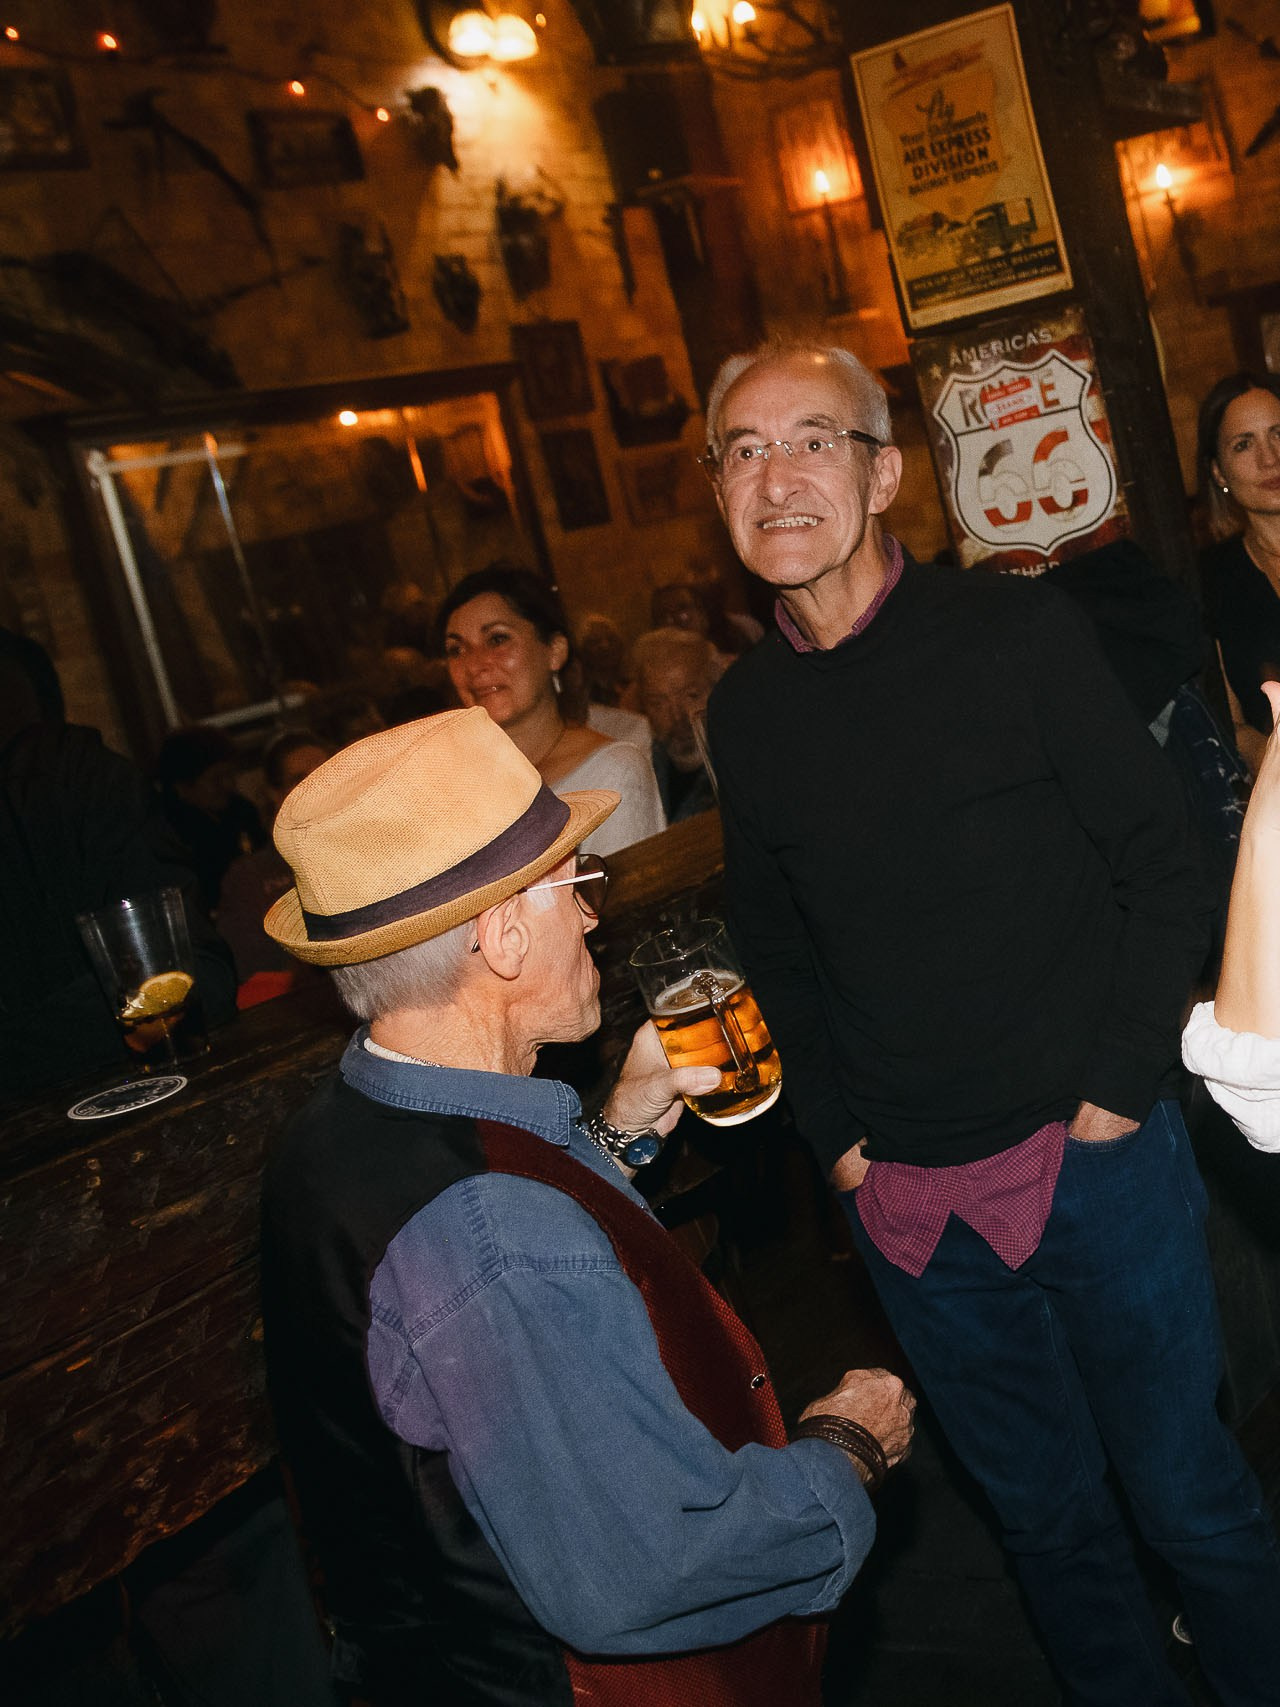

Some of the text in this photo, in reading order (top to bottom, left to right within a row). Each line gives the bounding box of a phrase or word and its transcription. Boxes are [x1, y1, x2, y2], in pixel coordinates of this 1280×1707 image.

[904, 127, 991, 165] AIR EXPRESS
[912, 146, 989, 180] DIVISION
[949, 327, 1053, 367] AMERICA'S
[977, 425, 1090, 535] 66
